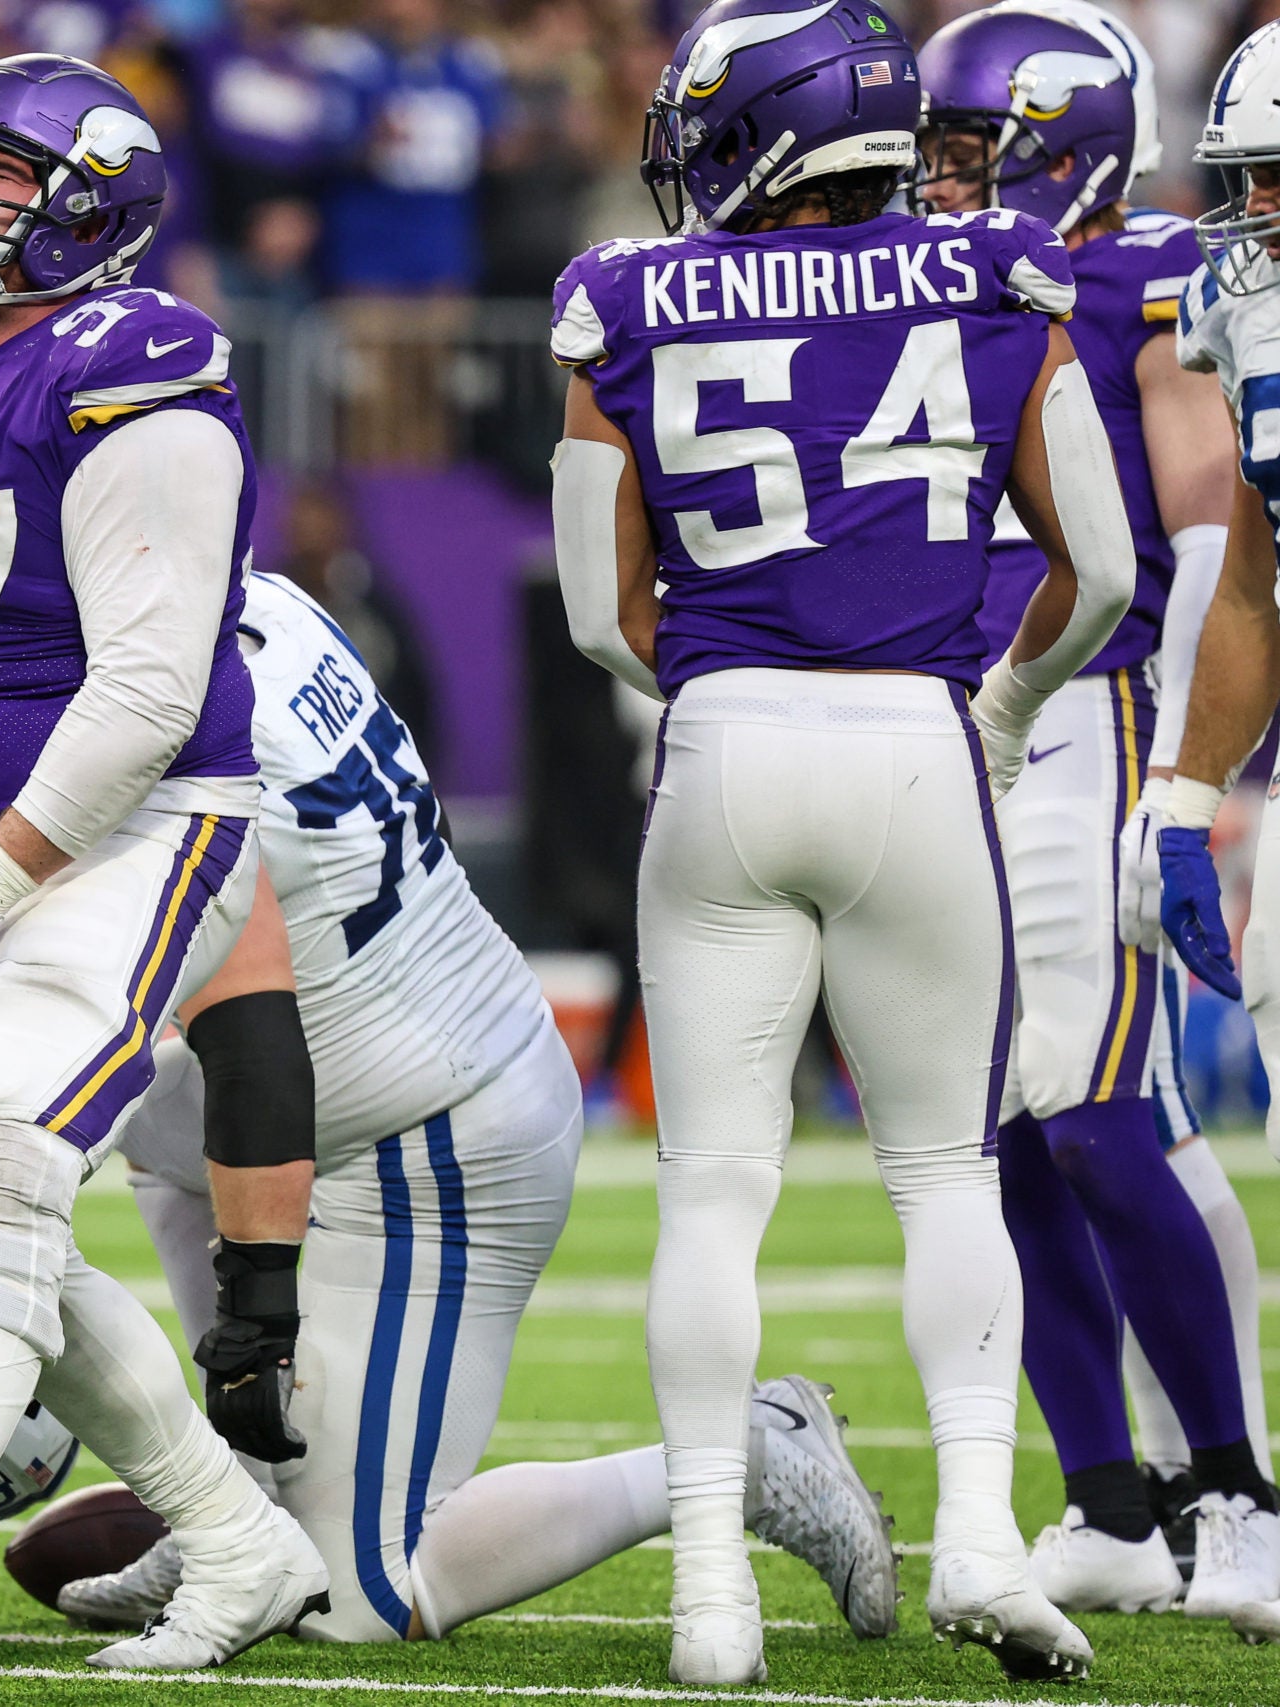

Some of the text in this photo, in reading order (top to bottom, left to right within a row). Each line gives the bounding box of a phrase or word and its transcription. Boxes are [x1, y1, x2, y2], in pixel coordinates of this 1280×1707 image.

[864, 141, 911, 152] CHOOSE LOVE
[642, 237, 979, 328] KENDRICKS
[650, 318, 988, 571] 54
[288, 652, 363, 755] FRIES
